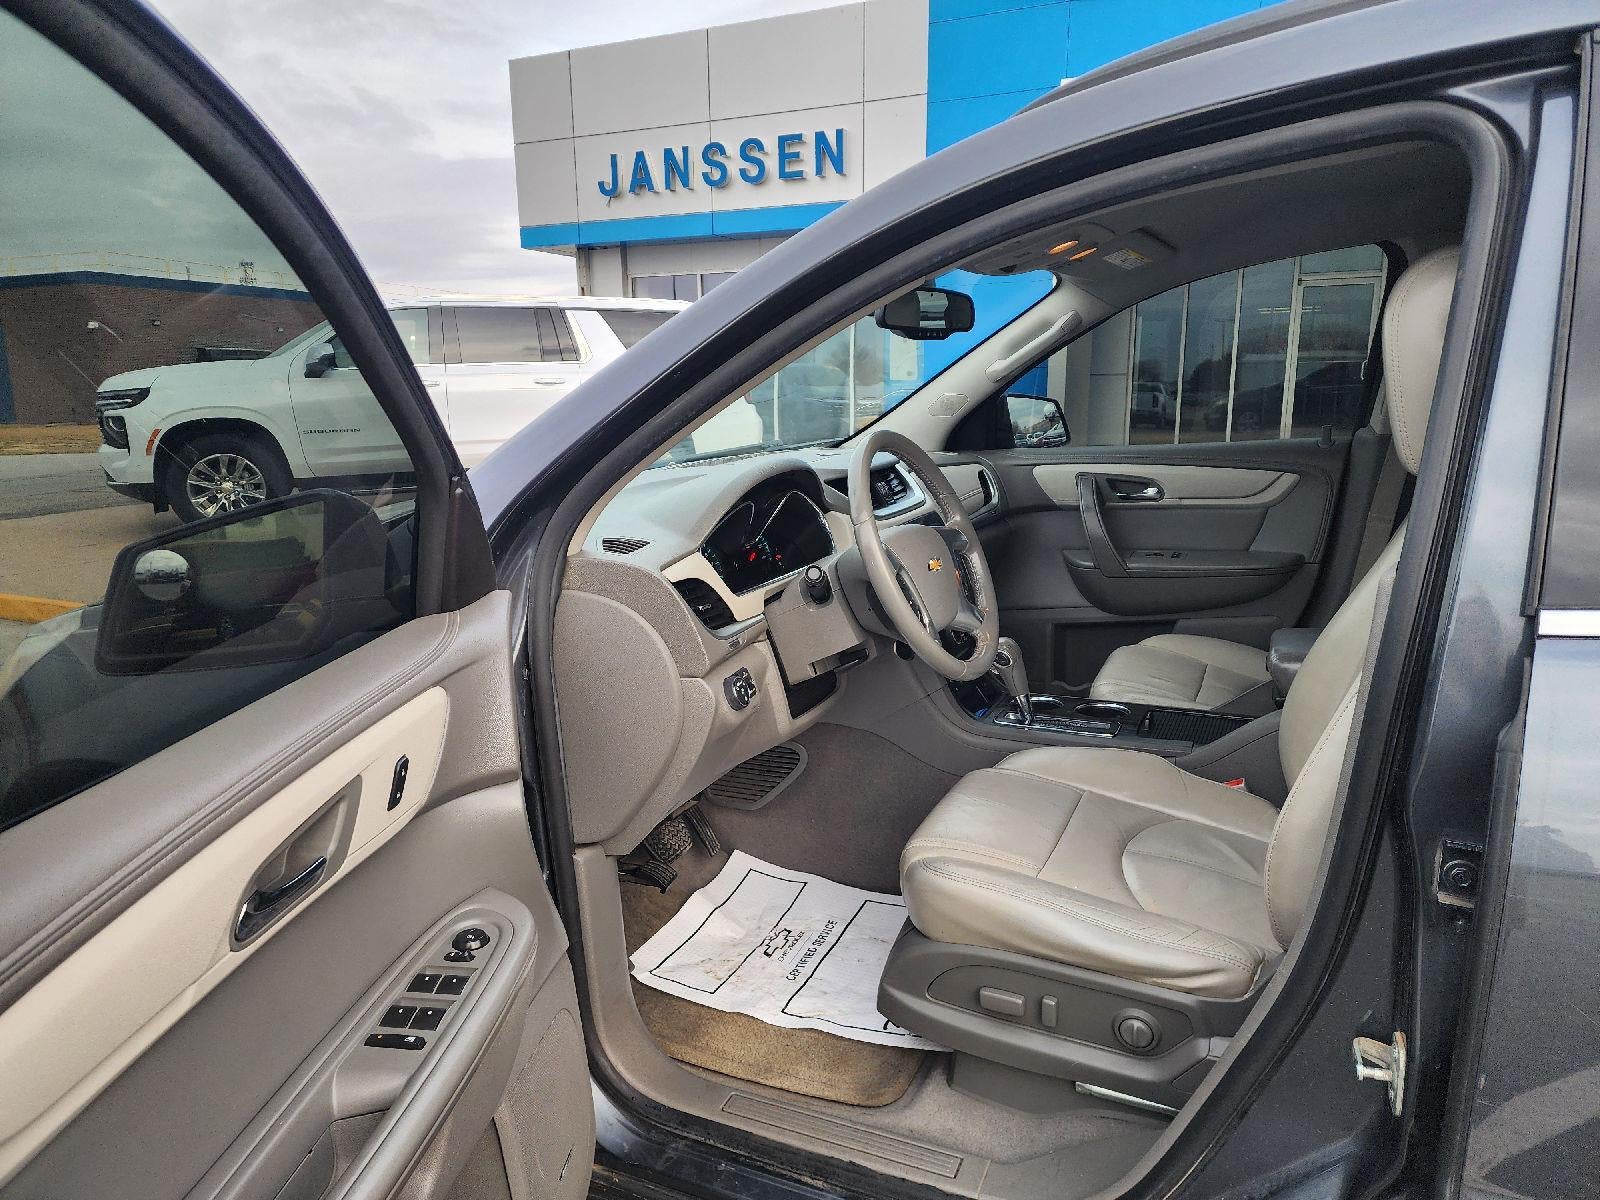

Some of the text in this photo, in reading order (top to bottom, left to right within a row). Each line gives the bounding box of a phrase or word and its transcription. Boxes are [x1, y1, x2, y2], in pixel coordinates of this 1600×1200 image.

[598, 128, 847, 198] JANSSEN
[785, 919, 838, 981] CERTIFIED SERVICE
